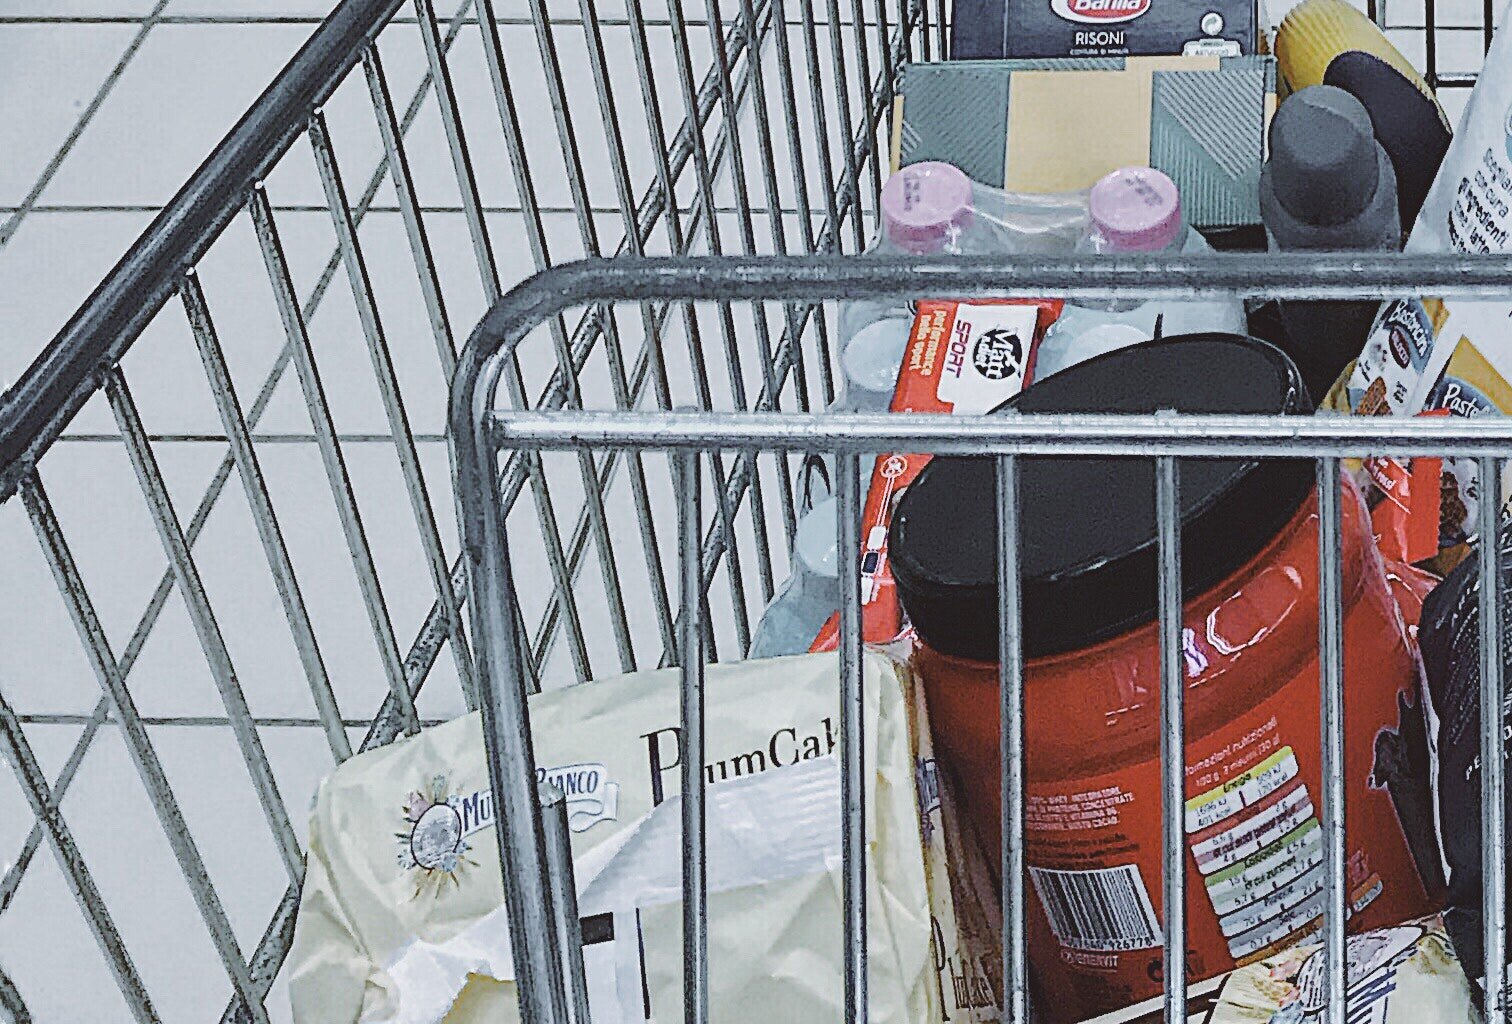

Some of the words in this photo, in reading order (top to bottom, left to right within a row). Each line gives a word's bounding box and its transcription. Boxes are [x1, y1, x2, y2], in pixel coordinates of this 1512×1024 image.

[1075, 31, 1124, 46] RISONI
[909, 341, 924, 371] sport
[921, 310, 948, 376] performance
[946, 319, 972, 379] SPORT
[640, 717, 838, 808] PumCak
[1185, 745, 1231, 776] formazioni
